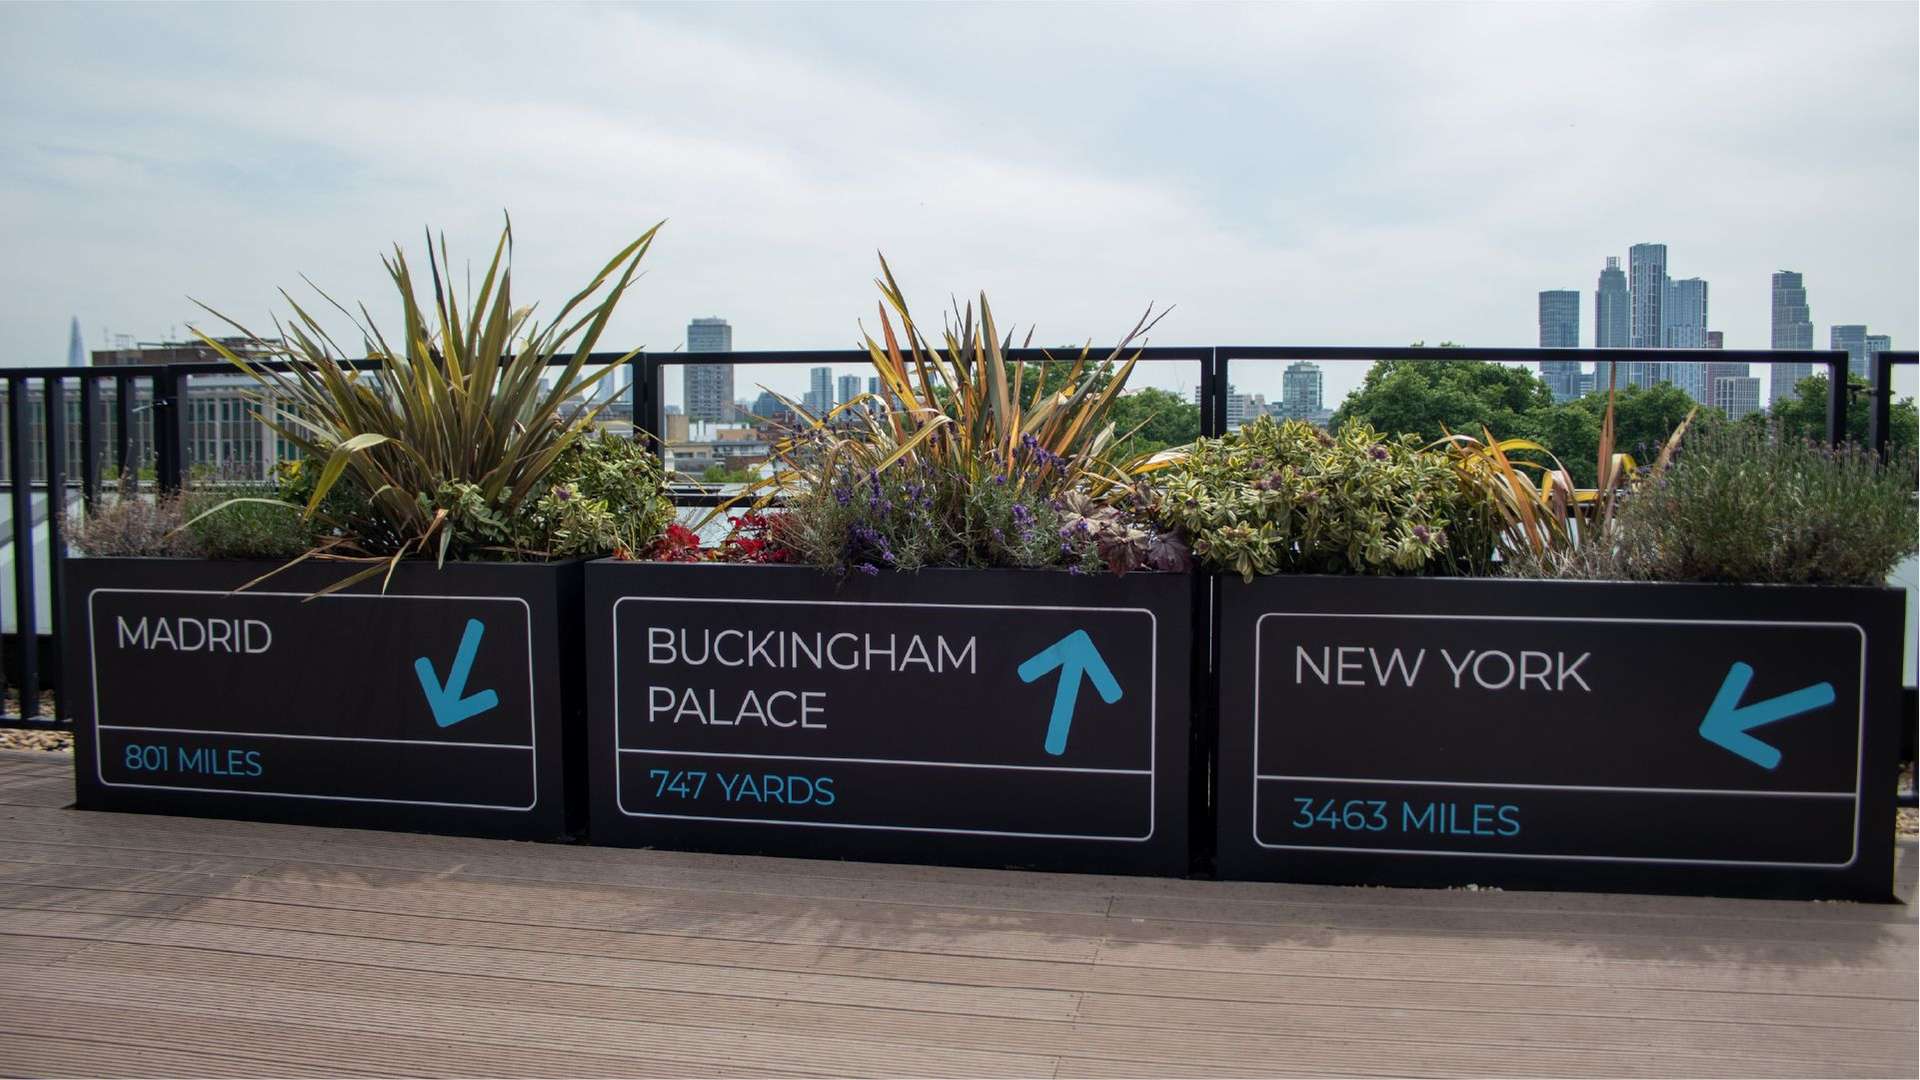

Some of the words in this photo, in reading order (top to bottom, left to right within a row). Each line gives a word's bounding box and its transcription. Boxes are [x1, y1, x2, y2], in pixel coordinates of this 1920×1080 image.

[117, 616, 272, 654] MADRID
[648, 627, 977, 674] BUCKINGHAM
[1296, 645, 1426, 687] NEW
[1440, 648, 1591, 692] YORK
[648, 685, 828, 729] PALACE
[125, 744, 168, 771] 801
[178, 747, 262, 776] MILES
[650, 769, 707, 799] 747
[716, 773, 835, 806] YARDS
[1293, 798, 1387, 831] 3463
[1403, 801, 1520, 836] MILES
